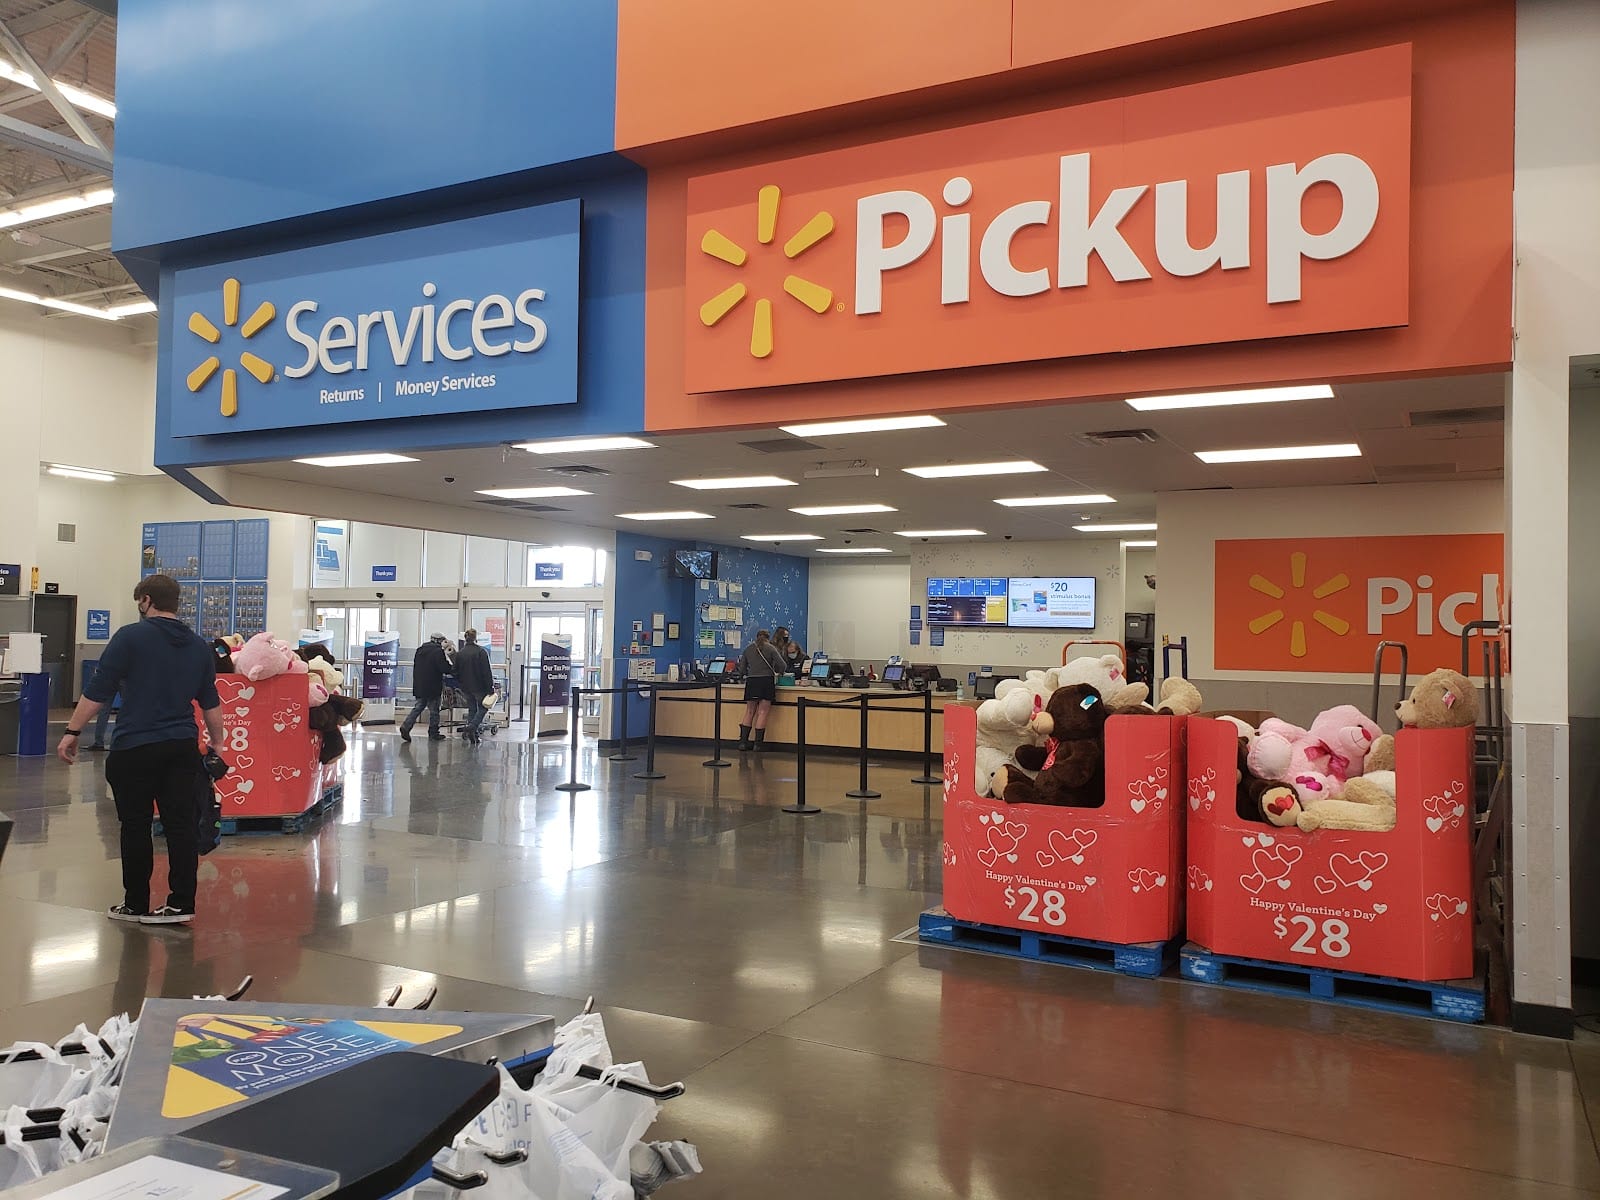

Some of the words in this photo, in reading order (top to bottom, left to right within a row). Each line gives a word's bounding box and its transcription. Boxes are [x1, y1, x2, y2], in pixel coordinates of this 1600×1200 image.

[855, 152, 1380, 315] Pickup
[284, 282, 548, 378] Services
[320, 388, 364, 404] Returns
[395, 380, 440, 396] Money
[441, 373, 496, 391] Services
[1050, 582, 1068, 592] $20
[986, 870, 1013, 884] Happy
[1015, 874, 1066, 889] Valentine's
[1068, 882, 1088, 893] Day
[1004, 885, 1067, 926] $28
[1250, 897, 1285, 912] Happy
[1288, 902, 1350, 918] Valentine's
[1353, 909, 1376, 922] Day
[1273, 913, 1351, 958] $28
[226, 1032, 326, 1066] ONE
[230, 1034, 376, 1082] MORE
